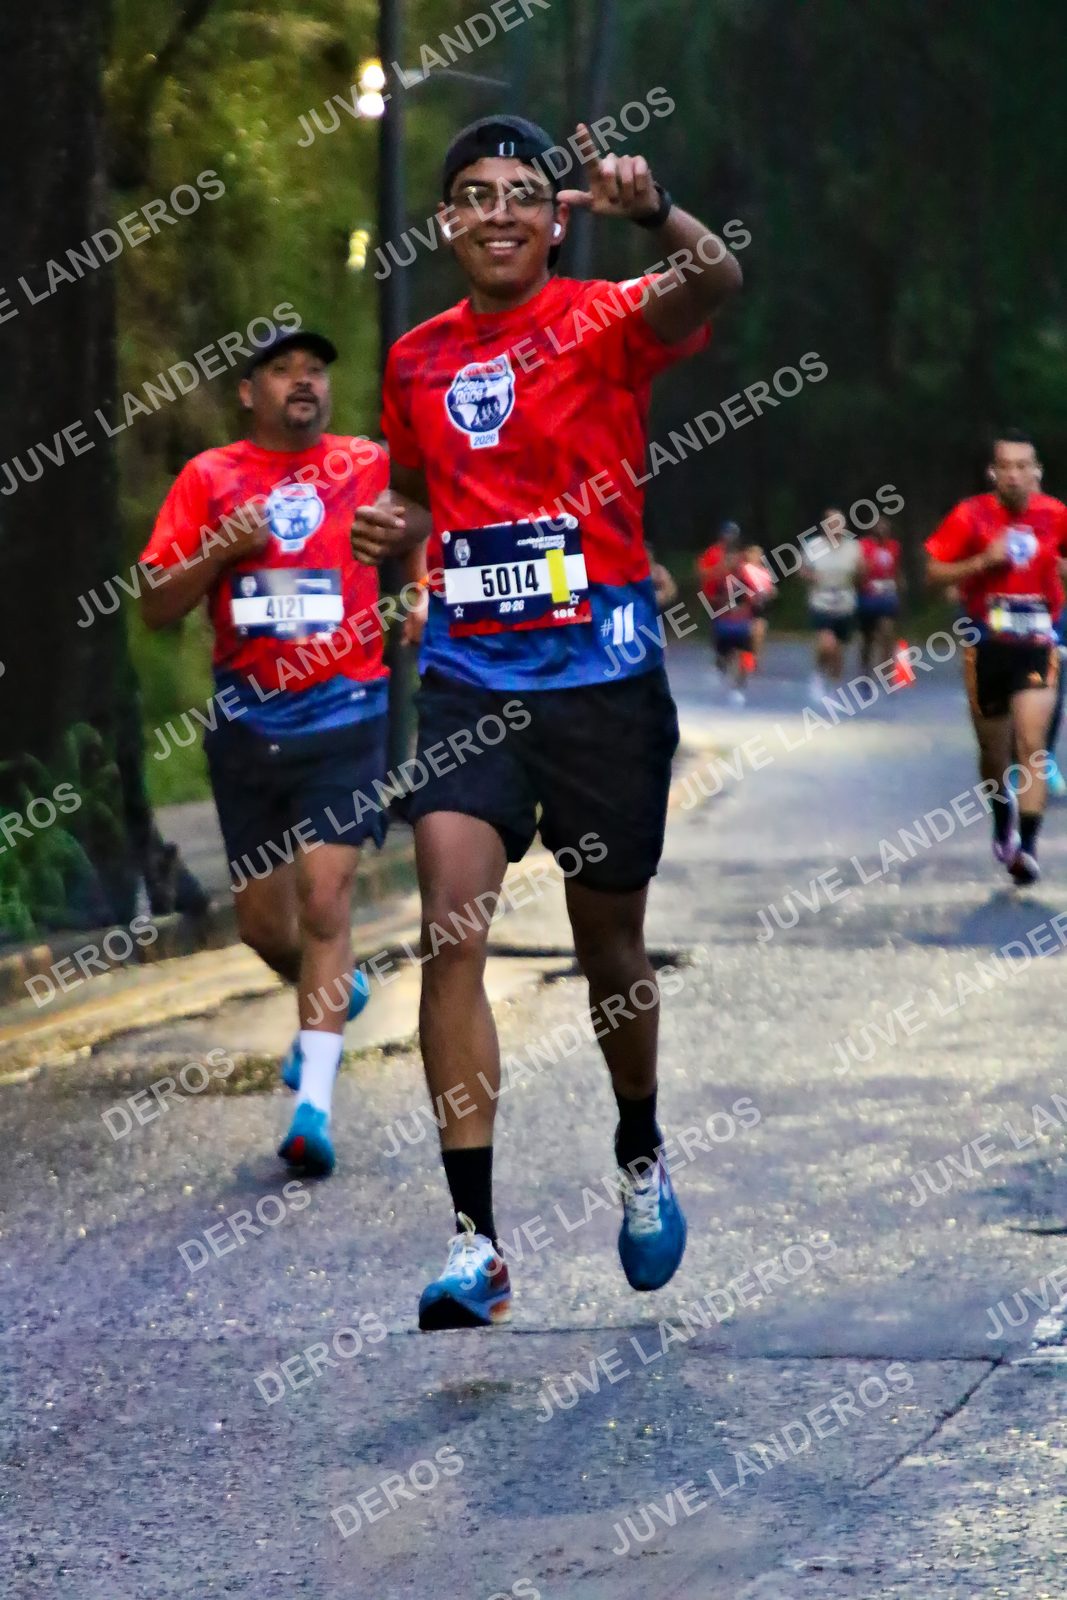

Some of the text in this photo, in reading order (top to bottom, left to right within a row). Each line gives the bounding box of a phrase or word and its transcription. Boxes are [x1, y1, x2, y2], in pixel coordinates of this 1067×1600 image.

[474, 433, 496, 446] 2026
[481, 563, 539, 598] 5014
[266, 597, 304, 619] 4121
[552, 607, 577, 619] 10K
